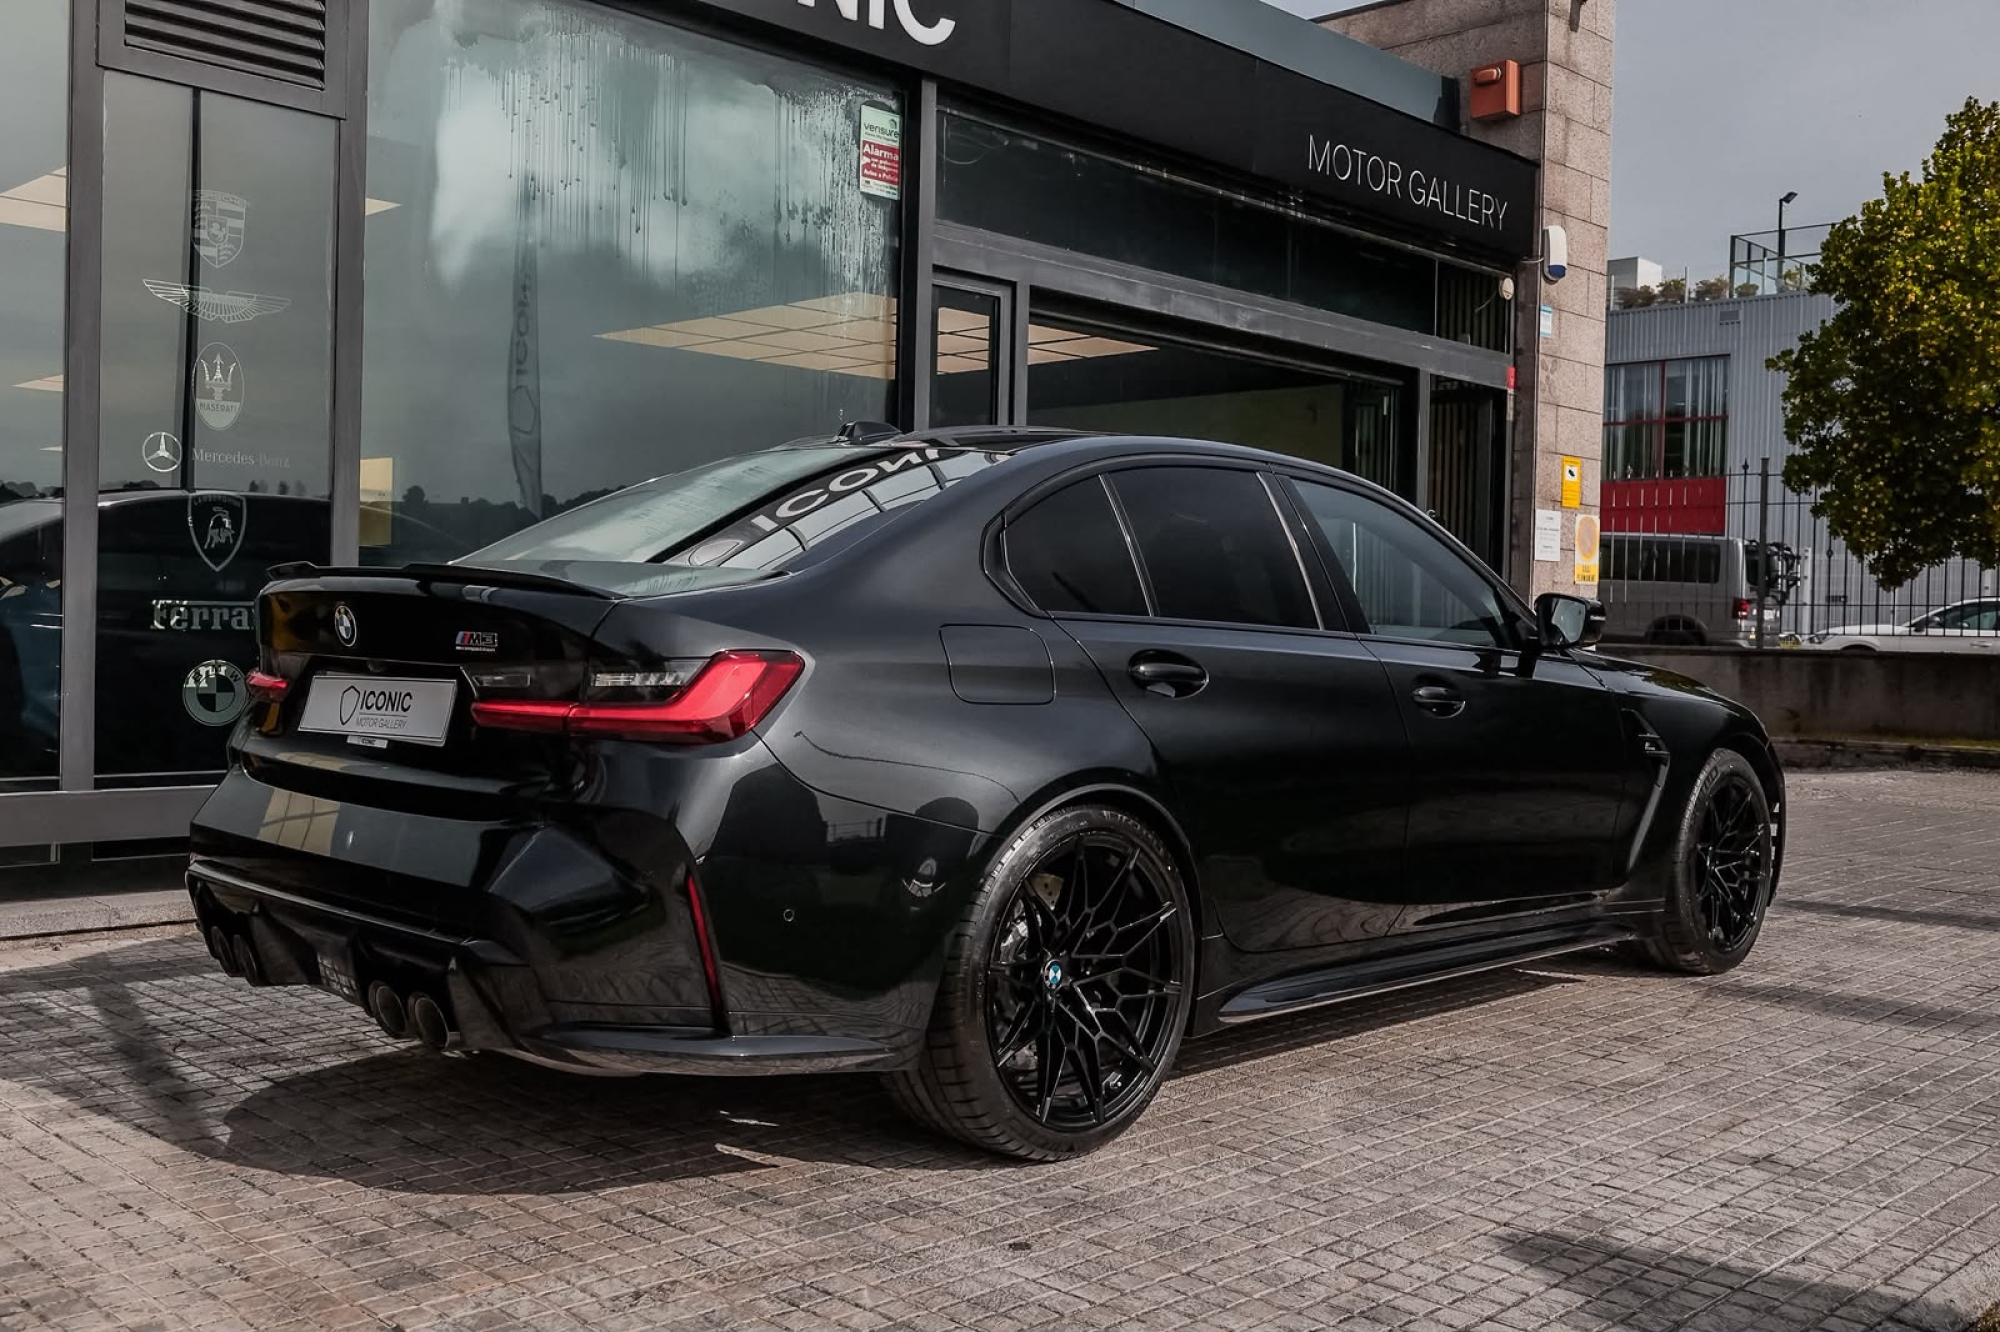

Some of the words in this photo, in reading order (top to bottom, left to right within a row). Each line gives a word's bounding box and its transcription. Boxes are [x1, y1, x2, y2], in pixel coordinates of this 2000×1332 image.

[863, 143, 899, 161] Alarma
[1308, 134, 1402, 199] MOTOR
[1408, 170, 1508, 231] GALLERY
[199, 403, 237, 413] MASERATI
[150, 600, 255, 631] Ferra
[468, 631, 499, 646] M3
[360, 690, 413, 713] ICONIC
[356, 716, 378, 728] MOTOR
[378, 717, 407, 730] GALLERY
